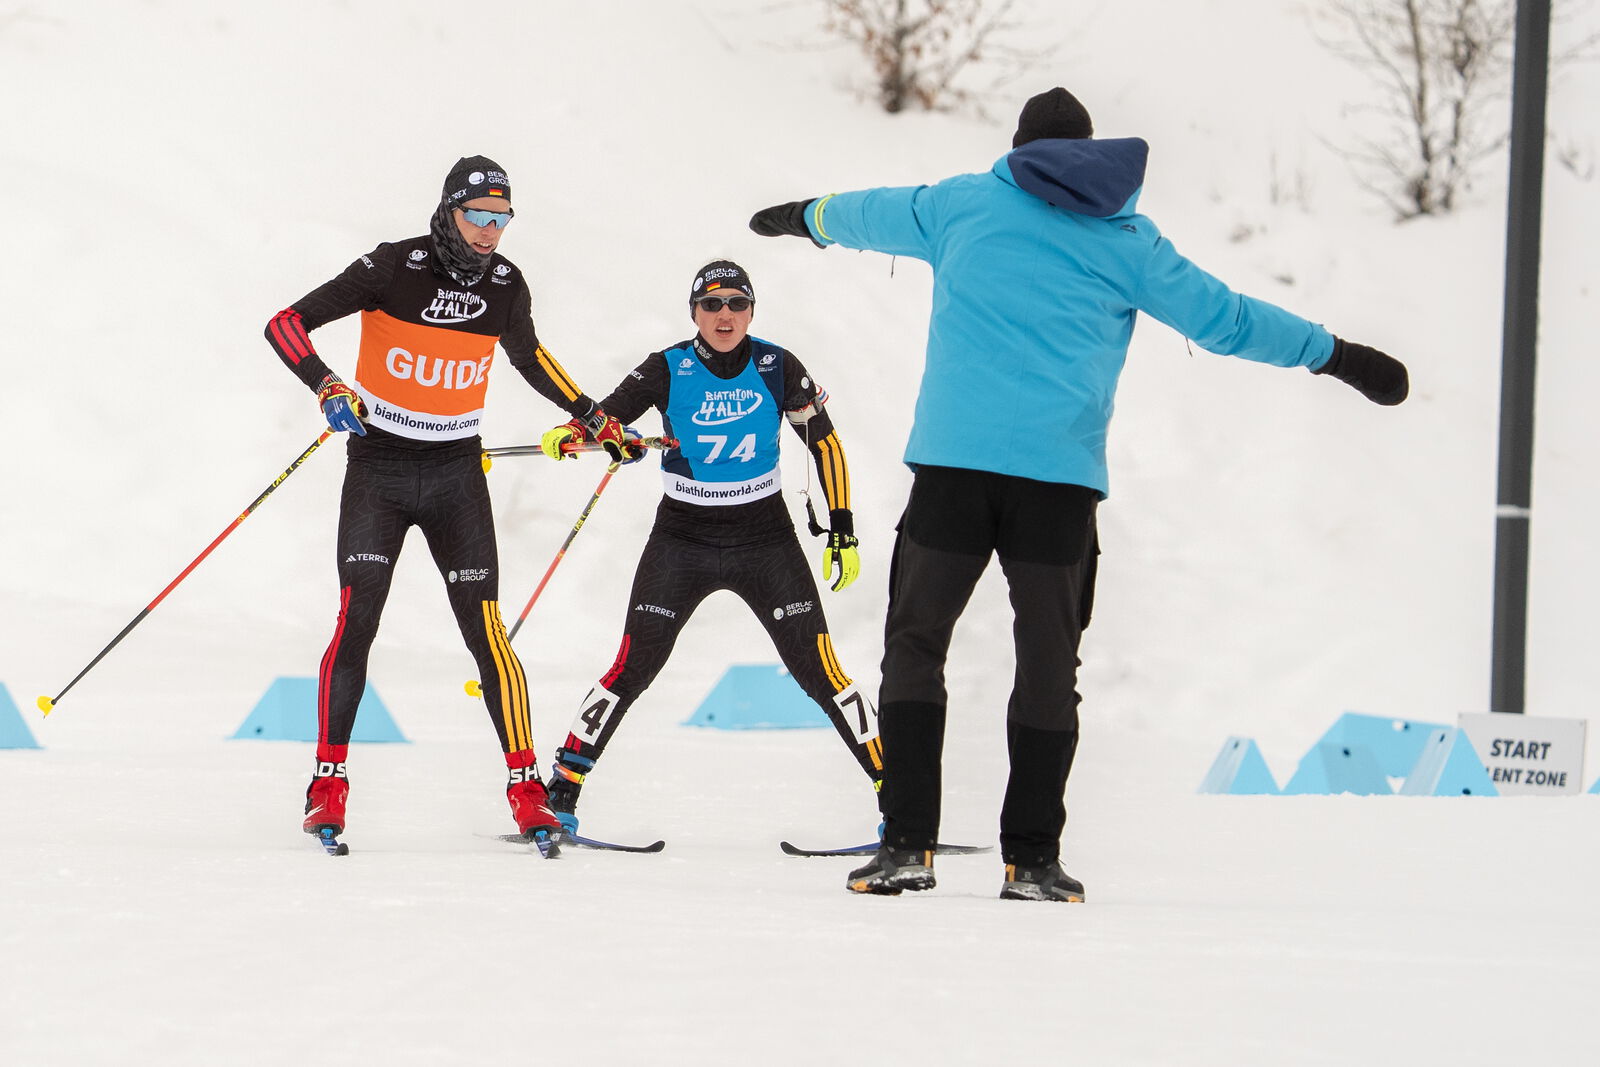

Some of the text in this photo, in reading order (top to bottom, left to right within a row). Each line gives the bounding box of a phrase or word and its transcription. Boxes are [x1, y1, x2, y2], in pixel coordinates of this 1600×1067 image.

[705, 268, 739, 277] BERLAC
[705, 272, 738, 281] GROUP
[429, 298, 472, 319] 4ALL
[385, 347, 493, 390] GUIDE
[374, 403, 480, 432] biathlonworld.com
[699, 401, 748, 420] 4ALL
[697, 433, 757, 464] 74
[675, 478, 774, 498] biathlonworld.com
[356, 553, 390, 565] TERREX
[459, 574, 486, 582] GROUP
[460, 568, 489, 576] BERLAC
[644, 604, 677, 619] TERREX
[785, 601, 813, 611] BERLAC
[787, 607, 812, 617] GROUP
[580, 688, 611, 737] 4
[840, 690, 877, 736] 7
[1490, 738, 1552, 760] START
[1486, 766, 1568, 788] ENT ZONE
